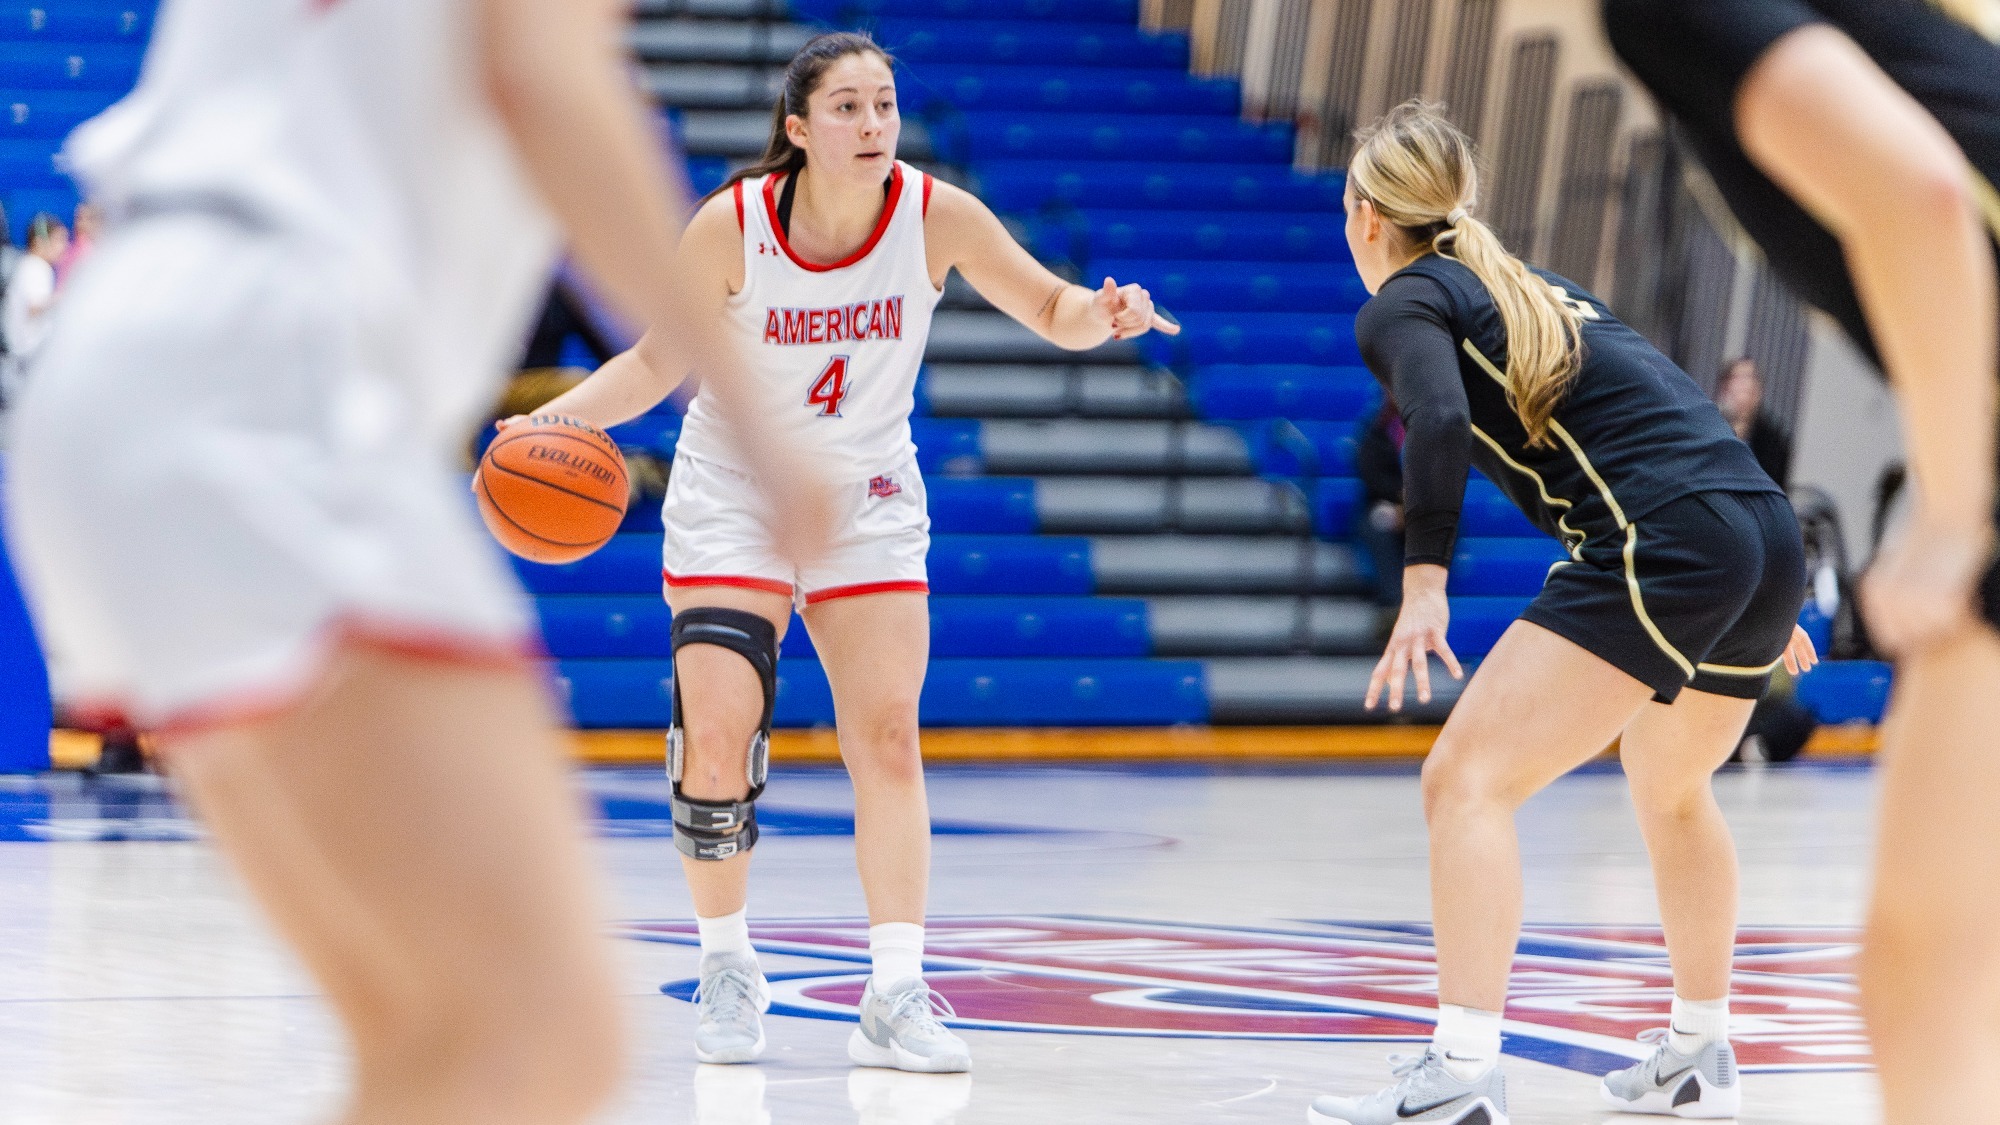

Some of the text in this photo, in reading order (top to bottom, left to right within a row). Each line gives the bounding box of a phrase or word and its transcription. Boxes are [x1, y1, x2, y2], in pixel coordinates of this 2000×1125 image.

[763, 295, 904, 345] AMERICAN
[804, 355, 852, 418] 4
[528, 445, 616, 487] EVOLUTION
